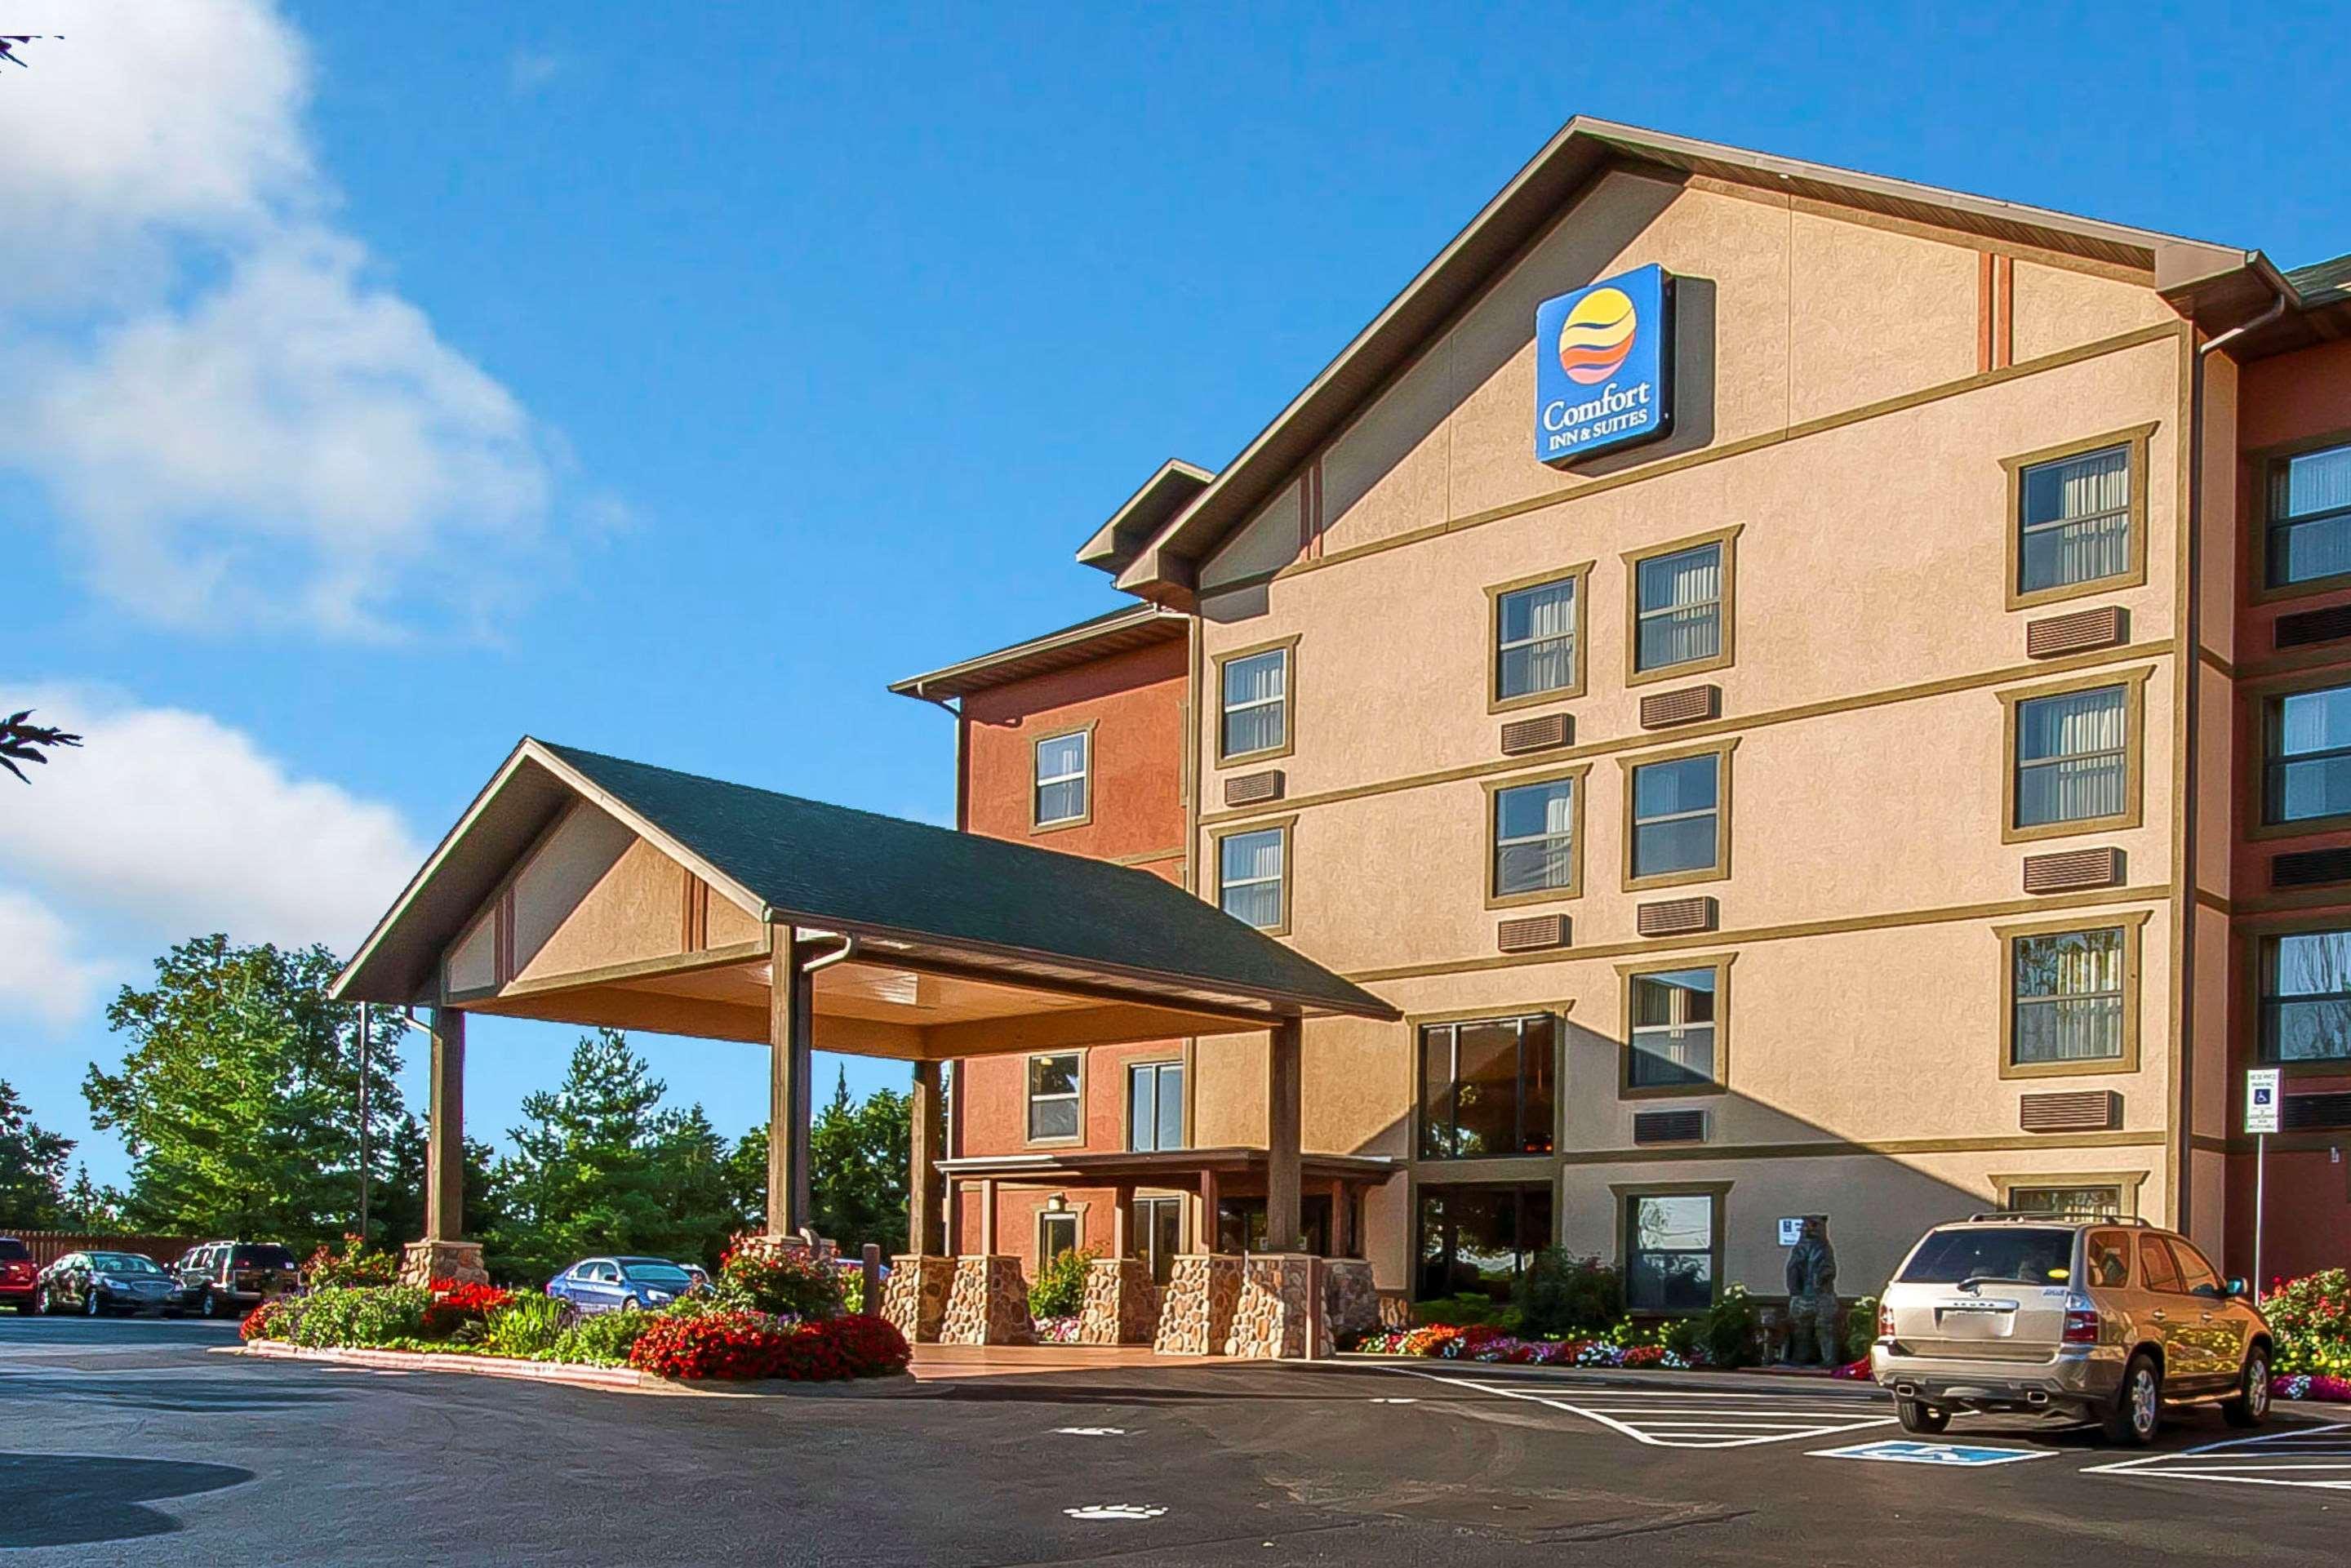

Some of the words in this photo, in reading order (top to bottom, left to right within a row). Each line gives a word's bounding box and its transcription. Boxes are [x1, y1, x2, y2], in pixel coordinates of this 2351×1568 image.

[1543, 382, 1651, 432] Comfort
[1549, 429, 1579, 451] INN
[1580, 427, 1592, 442] &
[1593, 408, 1648, 438] SUITES
